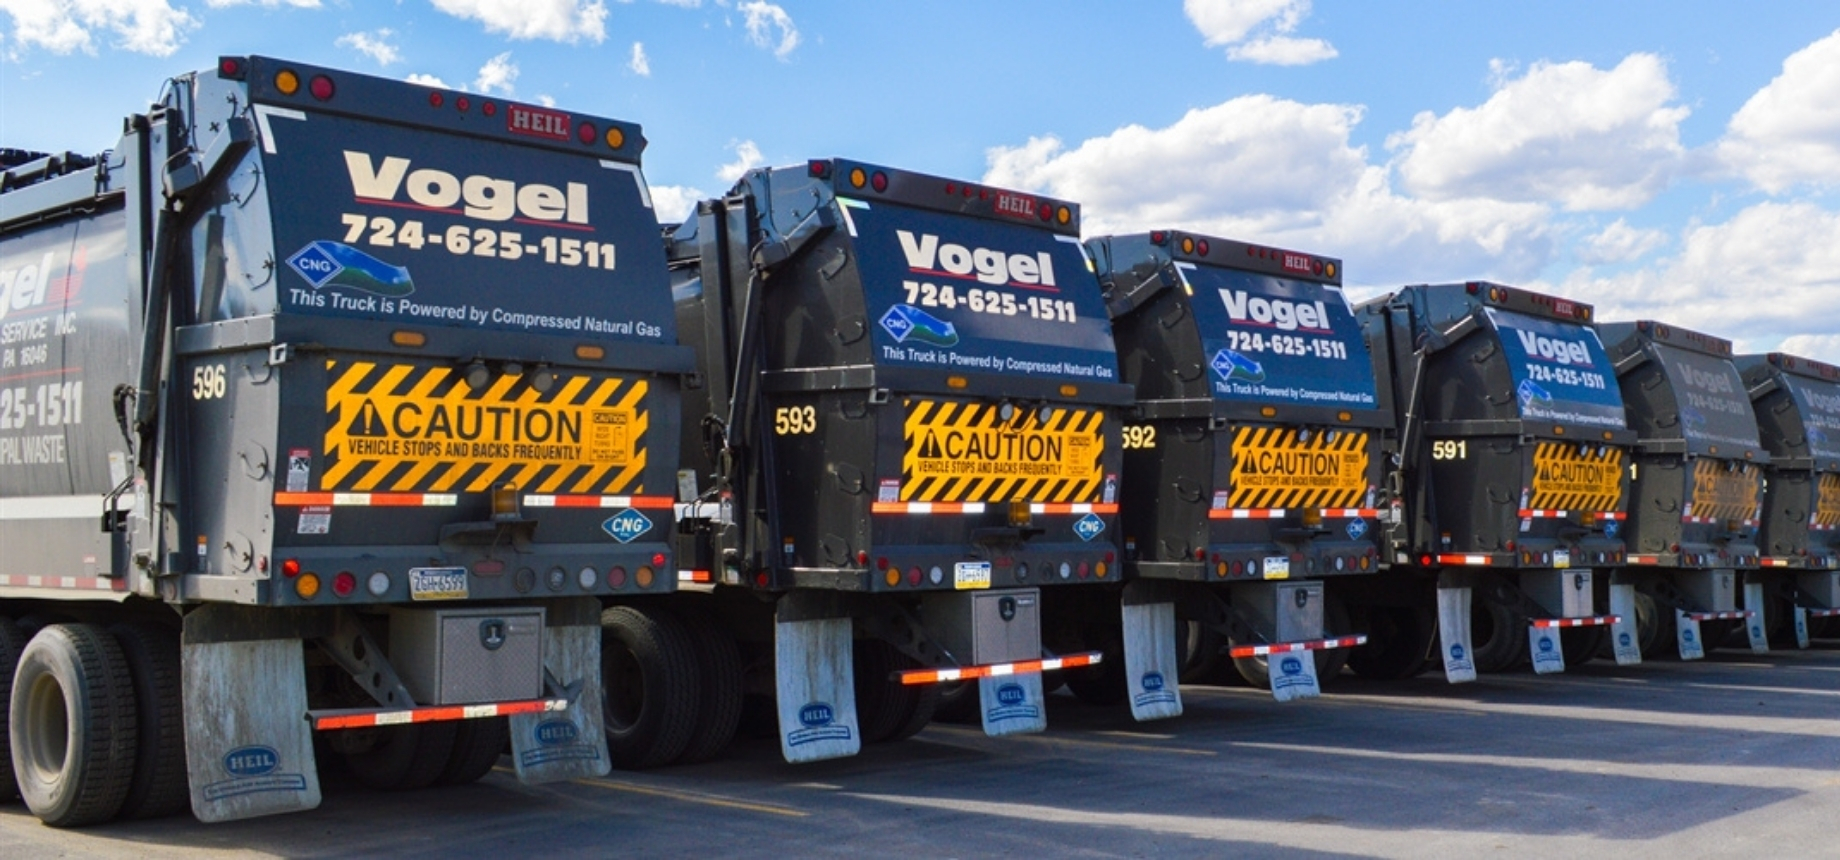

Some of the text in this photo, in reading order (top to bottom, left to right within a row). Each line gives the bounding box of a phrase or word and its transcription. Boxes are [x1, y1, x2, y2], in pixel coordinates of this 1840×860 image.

[513, 109, 567, 136] HEIL
[343, 150, 589, 225] Vogel
[999, 195, 1034, 215] HEIL
[342, 213, 616, 271] 724-625-1511
[299, 257, 332, 273] CNG
[896, 229, 1057, 286] Vogel
[1285, 255, 1311, 271] HEIL
[290, 289, 662, 338] This Truck is Powered by Compressed Natural Gas
[903, 281, 1077, 324] 724-625-1511
[1217, 288, 1331, 331] Vogel
[1, 312, 77, 344] SERVICE INC.
[887, 317, 907, 330] CNG
[3, 349, 16, 368] PA
[1226, 330, 1347, 360] 724-625-1511
[1516, 329, 1593, 365] Vogel
[883, 346, 1113, 378] This Truck is Powered by Compressed Natural Gas
[192, 363, 227, 400] 596
[1525, 363, 1606, 390] 724-625-1511
[1676, 362, 1734, 393] Vogel
[1215, 382, 1232, 394] This
[1232, 383, 1252, 395] Truck
[1260, 385, 1290, 398] Powered
[1290, 388, 1299, 400] by
[1299, 389, 1338, 401] Compressed
[1339, 391, 1361, 402] Natural
[1361, 393, 1374, 403] Gas
[391, 401, 583, 444] CAUTION
[775, 405, 817, 435] 593
[22, 435, 65, 464] WASTE
[348, 439, 583, 461] VEHICLE STOPS AND BACKS FREQUENTLY
[945, 431, 1063, 462] CAUTION
[1121, 425, 1156, 449] 592
[1433, 440, 1466, 460] 591
[917, 460, 950, 474] VEHICLE
[951, 461, 976, 474] STOPS
[976, 462, 993, 474] AND
[994, 462, 1018, 475] BACKS
[1019, 462, 1063, 476] FREQUENTLY
[1259, 451, 1340, 476] CAUTION
[1551, 462, 1605, 483] CAUTION
[612, 517, 644, 533] CNG
[1079, 521, 1099, 534] CNG
[540, 726, 574, 740] HEIL
[230, 754, 274, 770] HEIL
